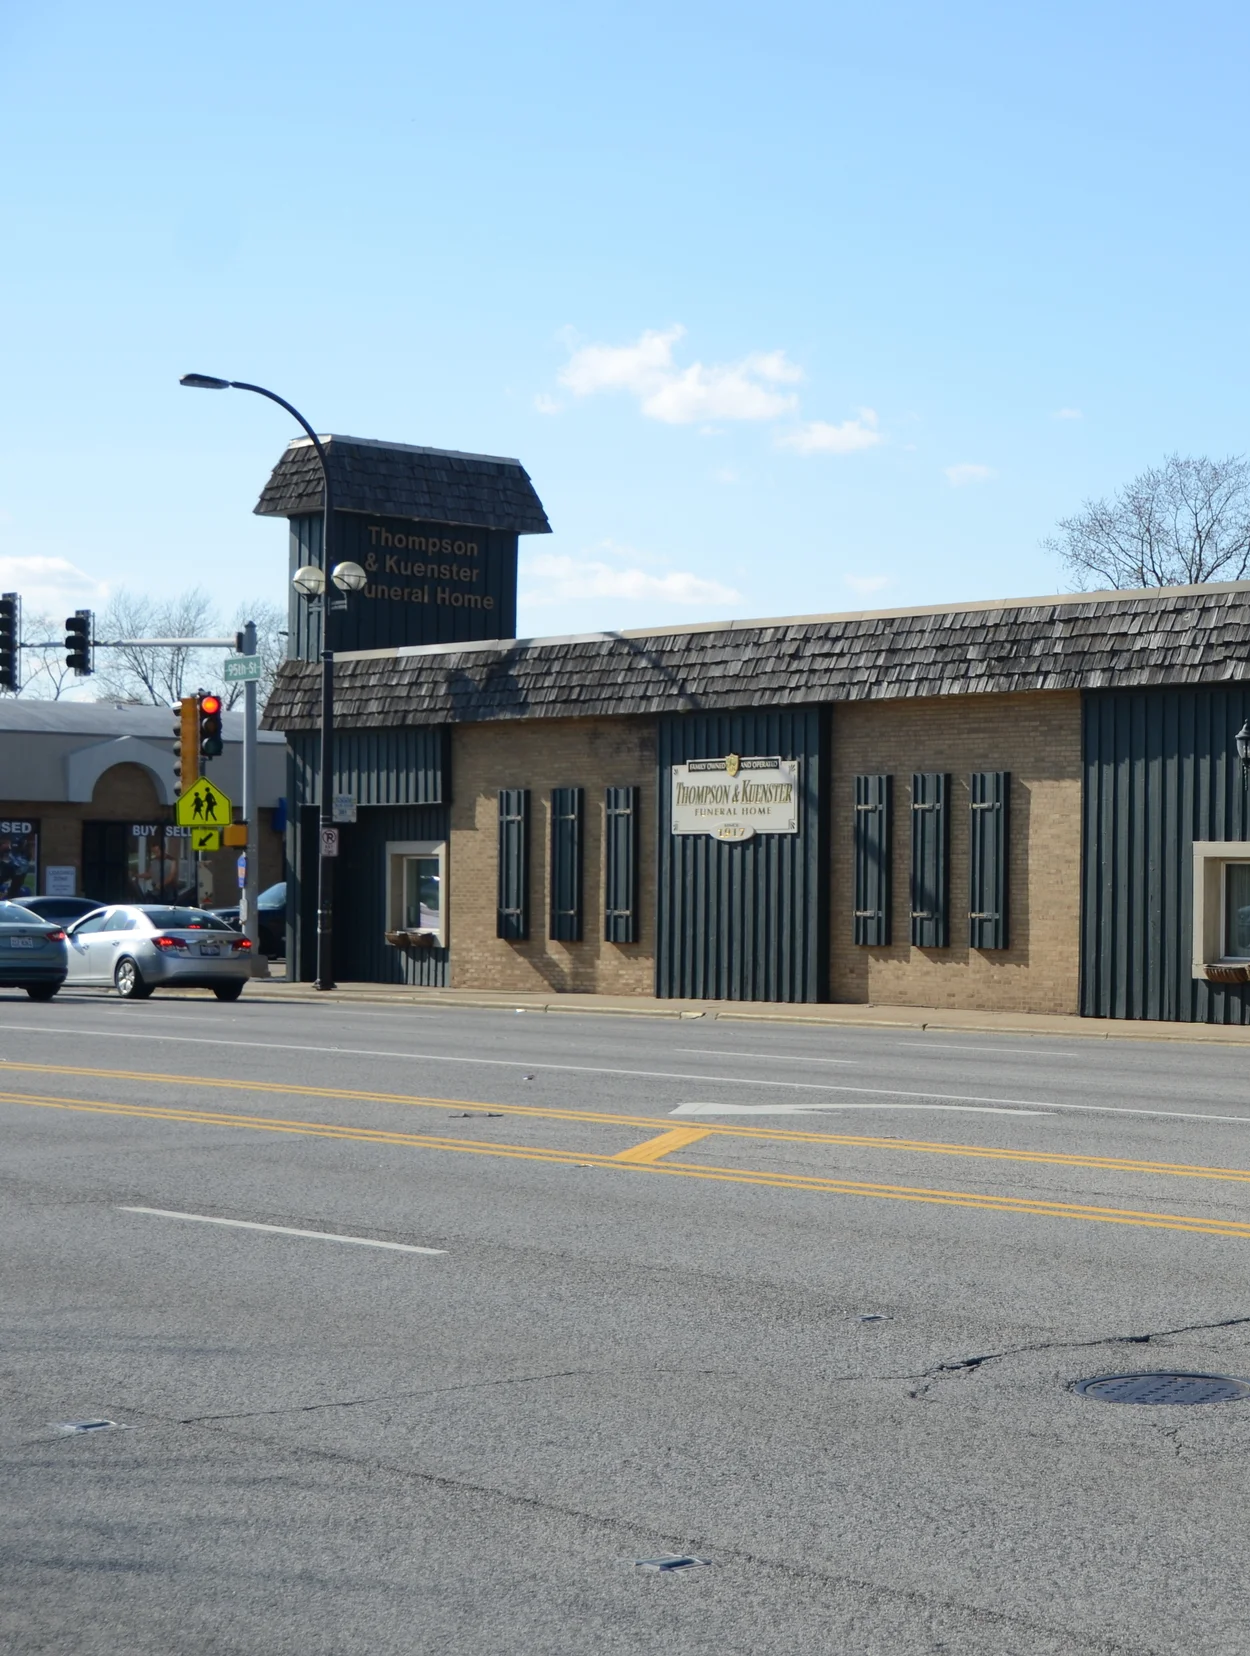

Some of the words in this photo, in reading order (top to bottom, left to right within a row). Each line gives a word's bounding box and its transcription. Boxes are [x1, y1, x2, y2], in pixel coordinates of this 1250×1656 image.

[368, 526, 478, 556] Thompson
[365, 552, 379, 572] &
[385, 554, 480, 582] Kuenster
[363, 583, 429, 604] uneral
[436, 586, 494, 610] Home
[228, 663, 246, 676] 95th
[248, 661, 257, 674] St
[707, 762, 726, 770] OWNED
[740, 761, 752, 769] AND
[676, 782, 731, 805] THOMPSON
[731, 784, 740, 804] &
[740, 780, 793, 804] KUENSTER
[695, 807, 738, 817] FUNERAL
[742, 806, 772, 816] HOME
[132, 825, 157, 836] BUY
[165, 826, 192, 837] SELL
[717, 828, 745, 838] 1917
